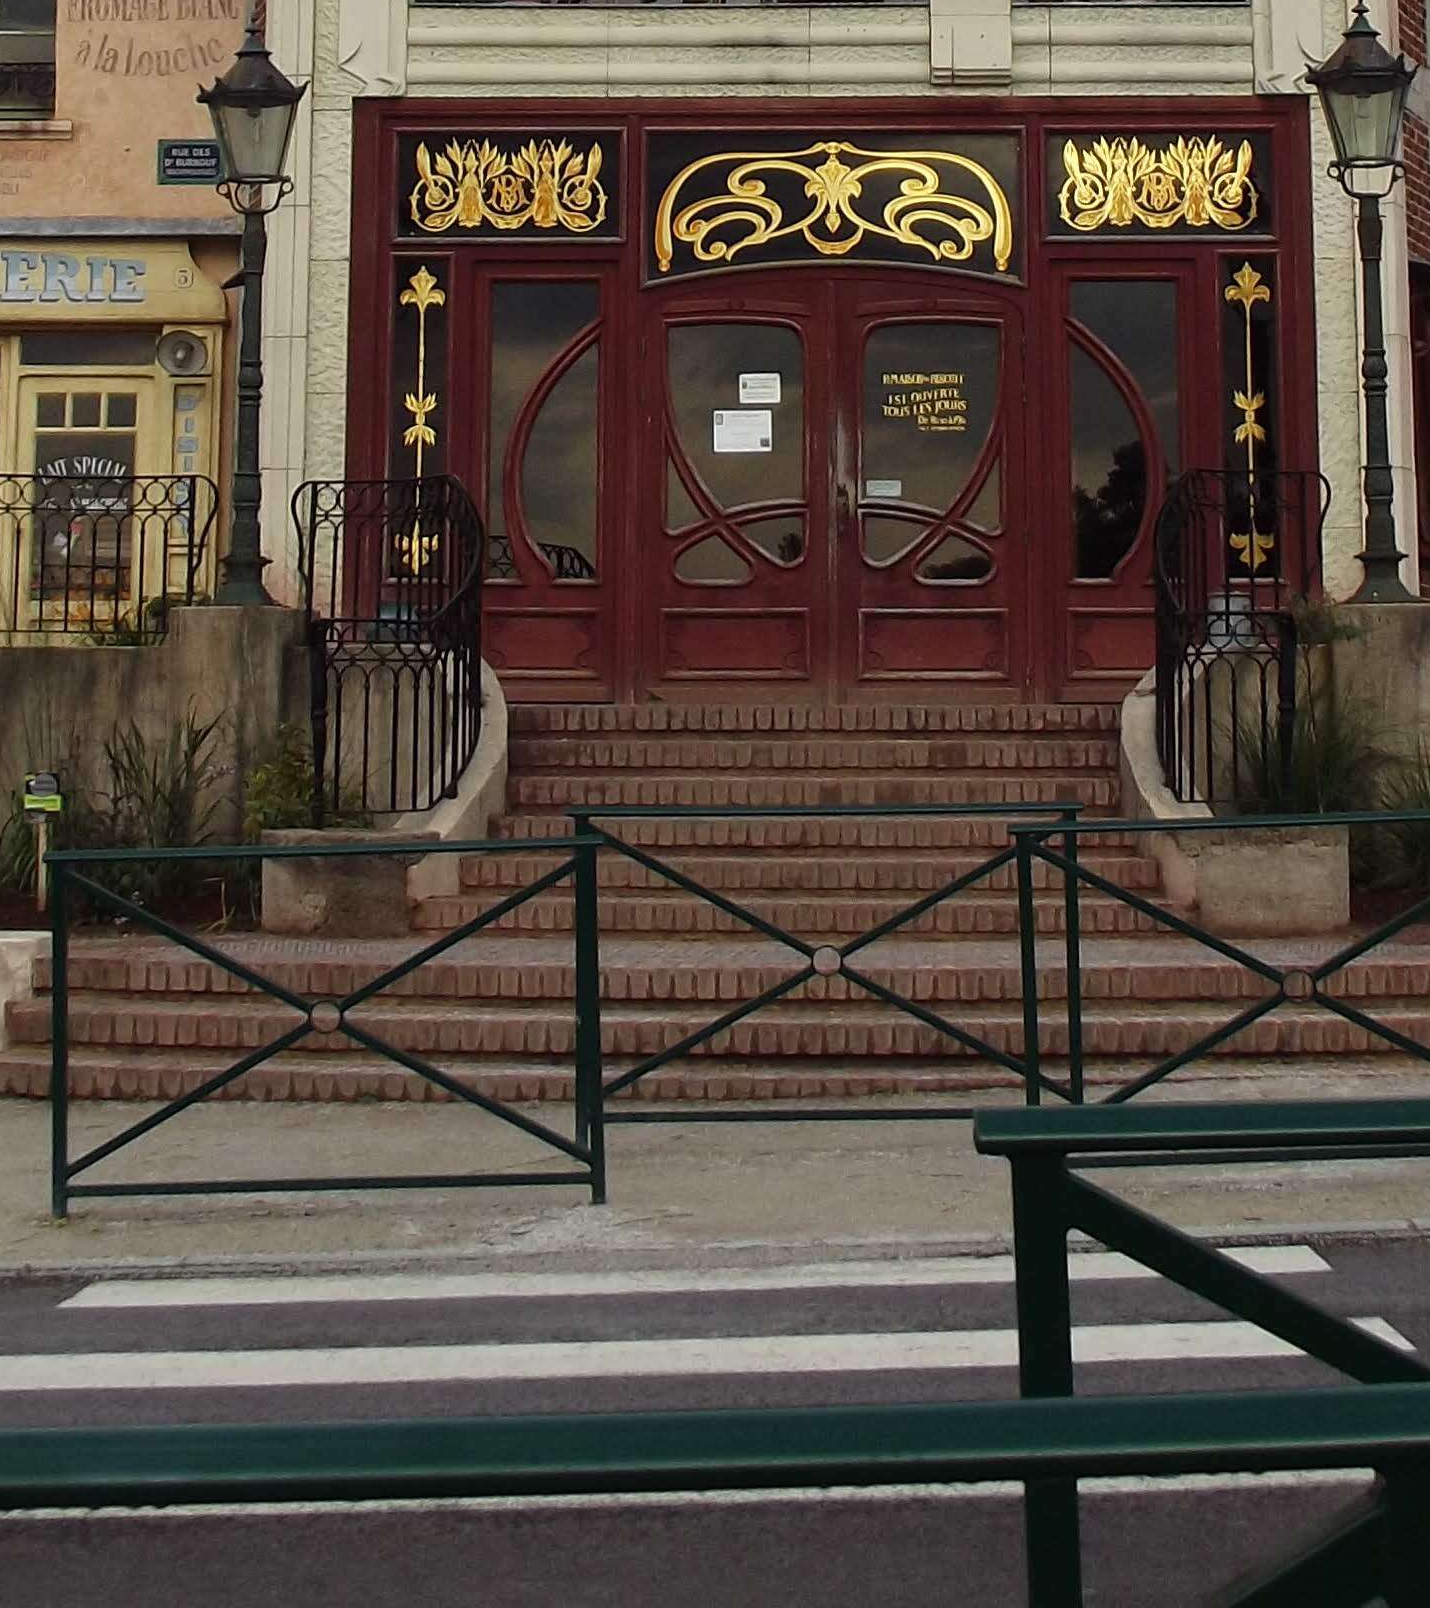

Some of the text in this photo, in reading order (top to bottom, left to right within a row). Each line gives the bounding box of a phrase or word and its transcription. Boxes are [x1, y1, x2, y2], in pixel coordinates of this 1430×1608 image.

[92, 33, 120, 73] la
[176, 269, 190, 287] 5
[882, 404, 911, 417] TOUS
[935, 400, 967, 414] JOURS
